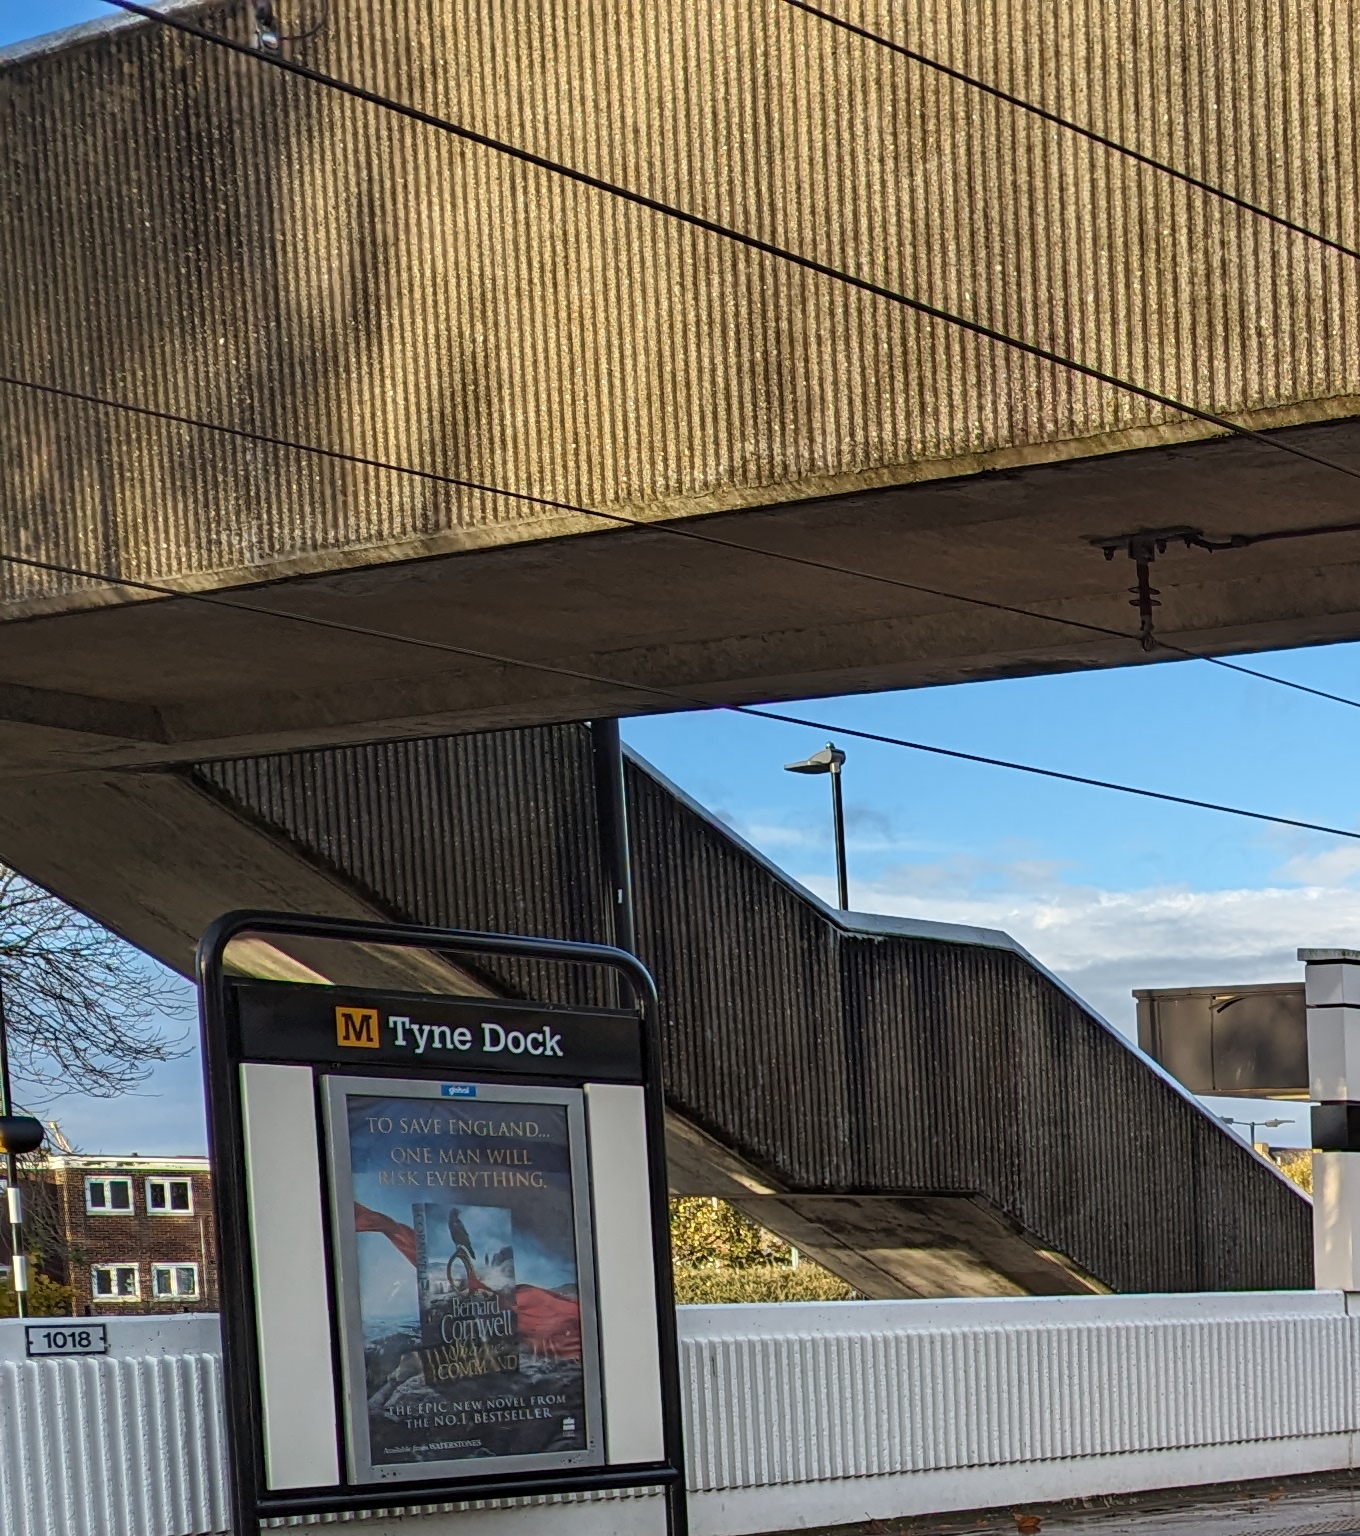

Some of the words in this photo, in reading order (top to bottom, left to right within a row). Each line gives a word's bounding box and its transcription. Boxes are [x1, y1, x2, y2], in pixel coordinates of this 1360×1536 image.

[341, 1013, 374, 1042] M
[388, 1015, 472, 1054] Tyne
[481, 1022, 564, 1057] Dock
[366, 1117, 393, 1133] TO
[399, 1117, 442, 1134] SAVE
[449, 1119, 550, 1138] ENGLAND...
[390, 1147, 432, 1164] ONE
[439, 1149, 480, 1165] MAN
[486, 1149, 533, 1165] WILL
[378, 1171, 420, 1186] RISK
[426, 1171, 548, 1188] EVERYTHING.
[452, 1295, 500, 1317] Bernard
[441, 1309, 513, 1344] Cornwell
[42, 1331, 92, 1349] 1018
[387, 1404, 412, 1417] THE
[418, 1401, 447, 1415] EPIC
[453, 1400, 483, 1412] NEW
[486, 1397, 525, 1410] NOVEL
[530, 1394, 566, 1406] FROM
[404, 1418, 430, 1429] THE
[434, 1412, 467, 1427] NO.1
[473, 1407, 553, 1424] BESTSELLER
